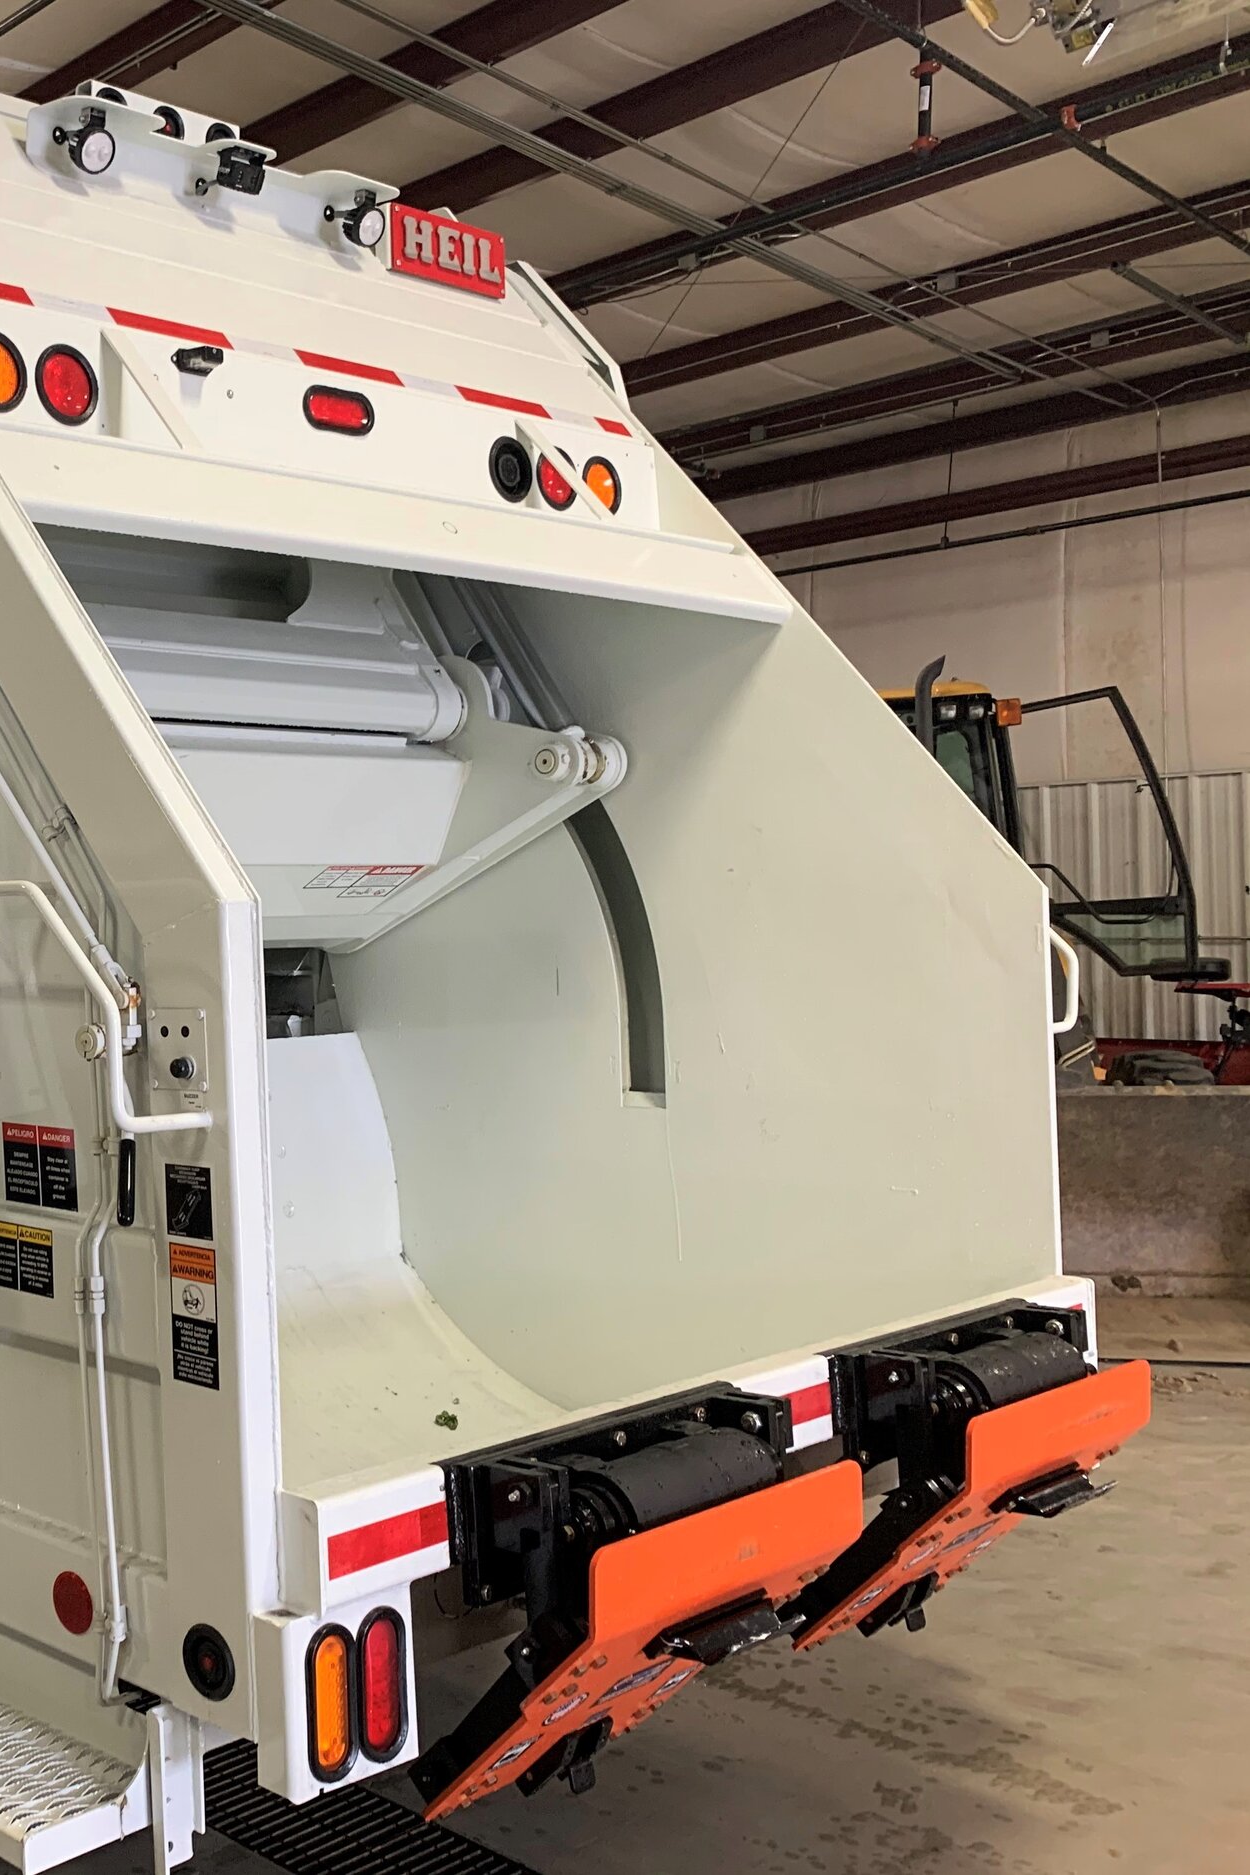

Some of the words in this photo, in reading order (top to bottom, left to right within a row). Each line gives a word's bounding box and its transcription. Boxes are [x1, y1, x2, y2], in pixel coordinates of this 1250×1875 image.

[403, 216, 502, 283] HEIL
[11, 1128, 35, 1139] PELIGRO
[47, 1133, 71, 1143] DANGER
[24, 1230, 51, 1241] CAUTION
[178, 1264, 214, 1280] WARNING
[175, 1320, 183, 1328] DO
